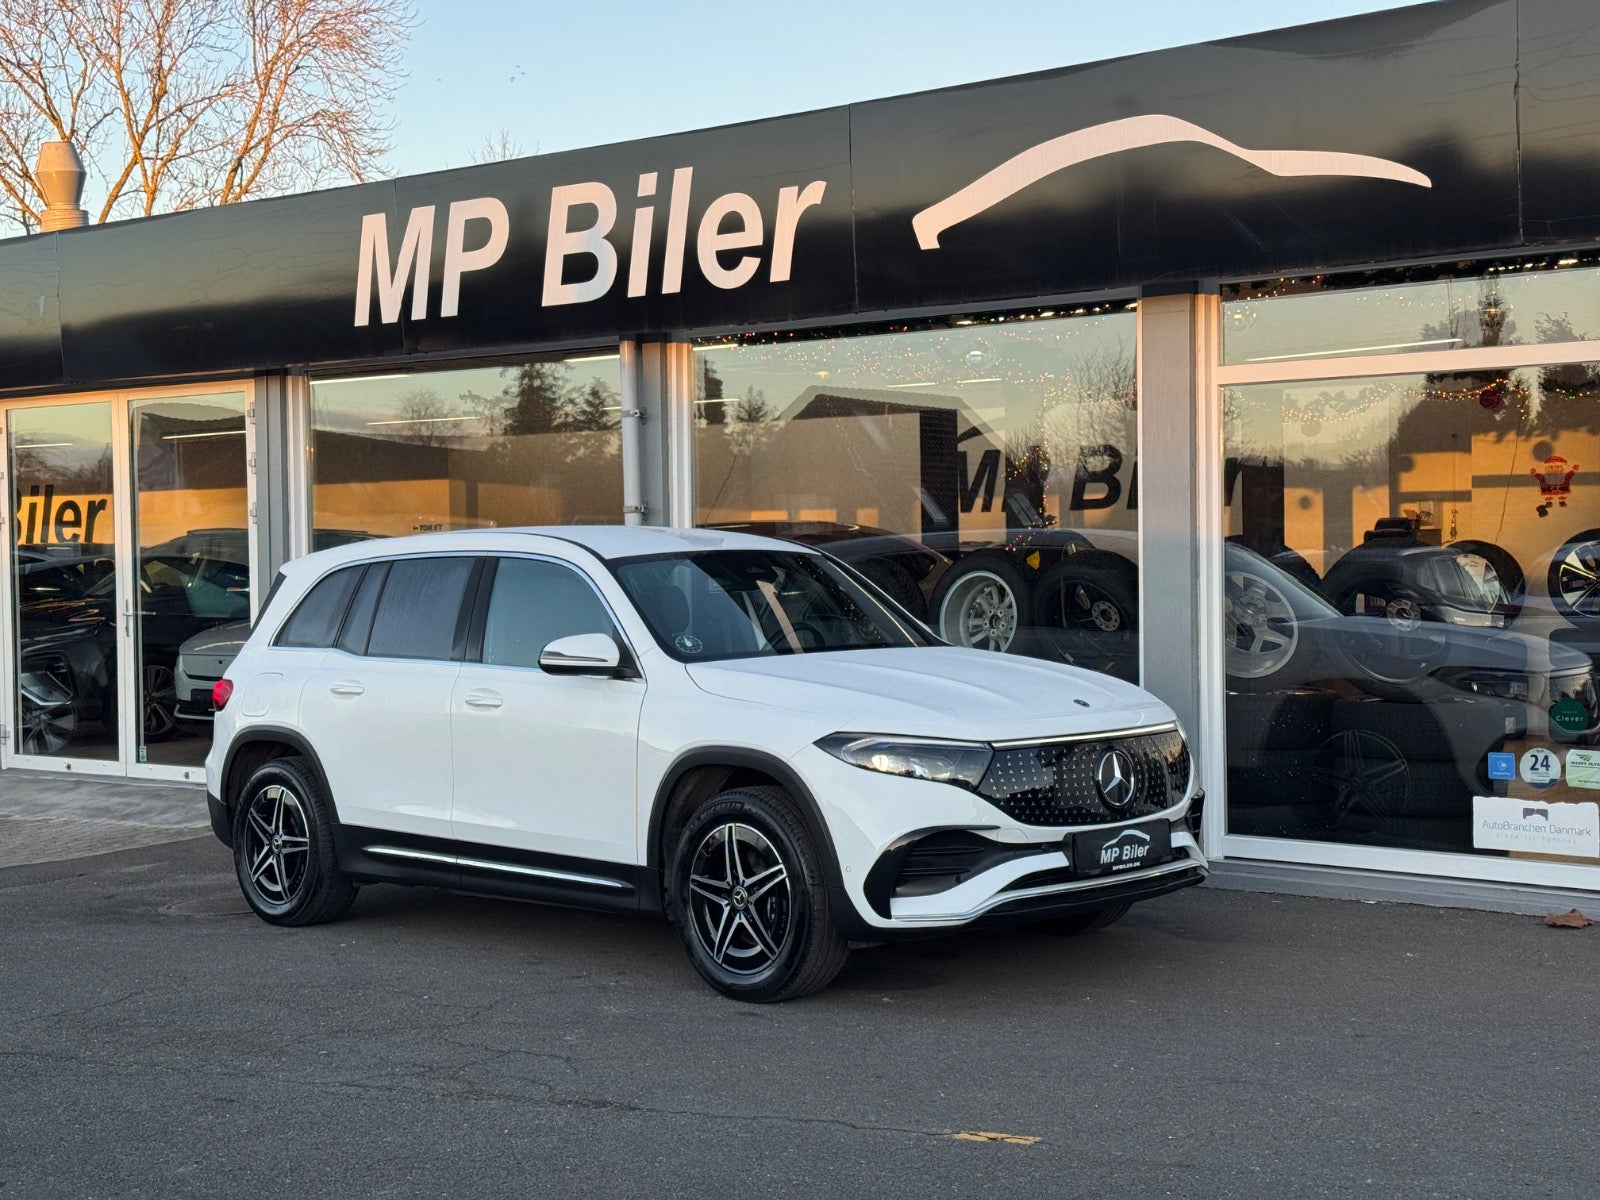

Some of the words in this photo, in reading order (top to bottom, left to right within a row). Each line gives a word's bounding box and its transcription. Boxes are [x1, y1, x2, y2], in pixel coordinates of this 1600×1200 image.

[354, 196, 510, 328] MP
[541, 166, 827, 308] Biler
[17, 485, 107, 543] iler
[1529, 754, 1551, 772] 24
[1482, 820, 1547, 833] AutoBranchen
[1549, 824, 1591, 836] Danmark
[1100, 847, 1120, 864] MP
[1122, 844, 1149, 860] Biler
